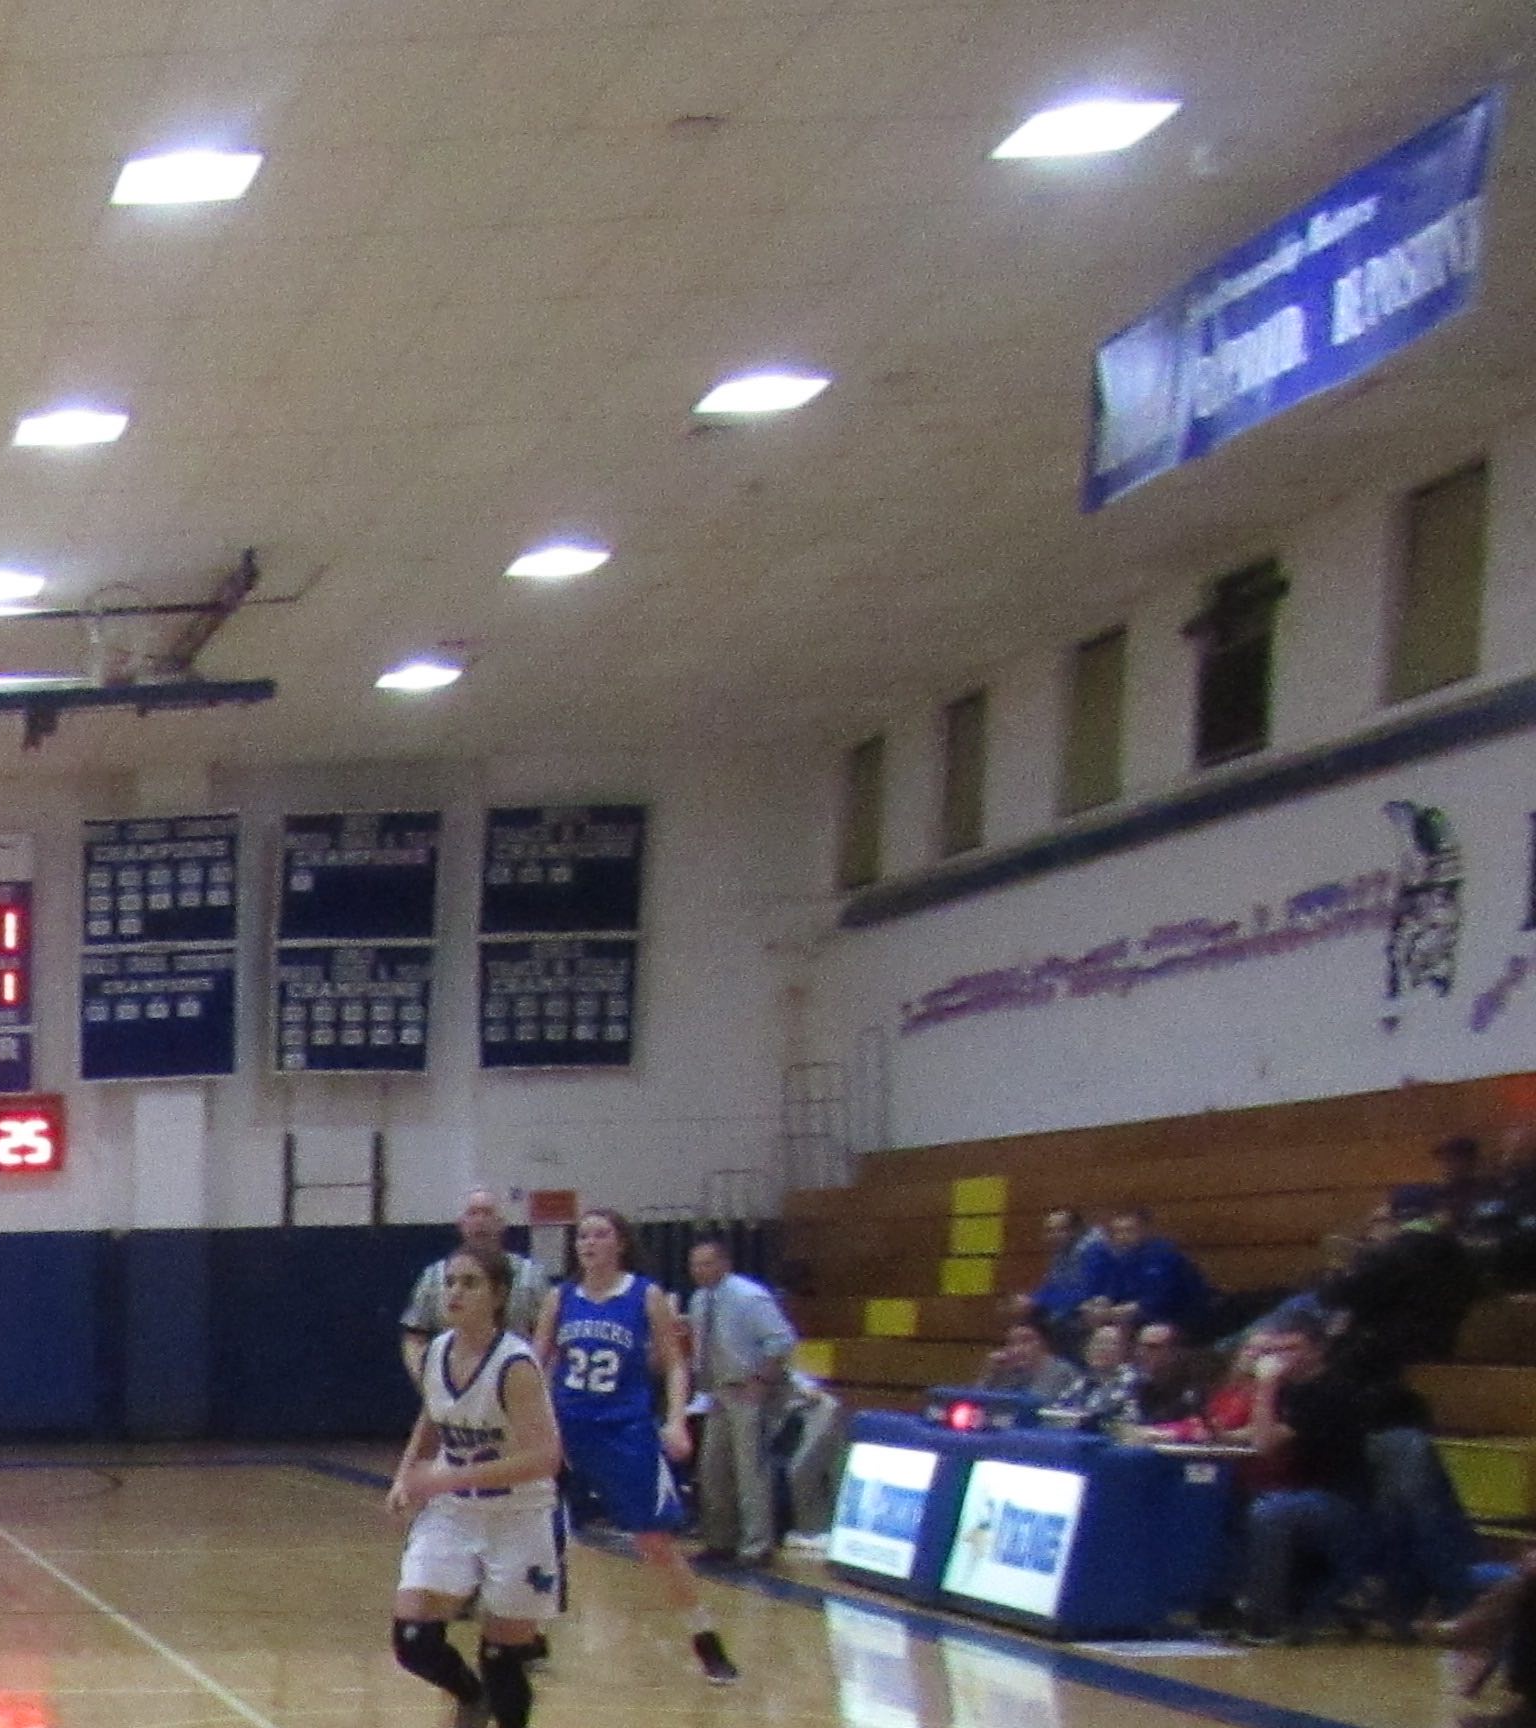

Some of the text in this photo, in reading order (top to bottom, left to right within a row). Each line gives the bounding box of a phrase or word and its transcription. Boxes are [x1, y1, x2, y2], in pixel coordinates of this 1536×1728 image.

[2, 970, 17, 1003] 1
[287, 981, 422, 999] CHAMPIONS
[564, 1348, 619, 1394] 22
